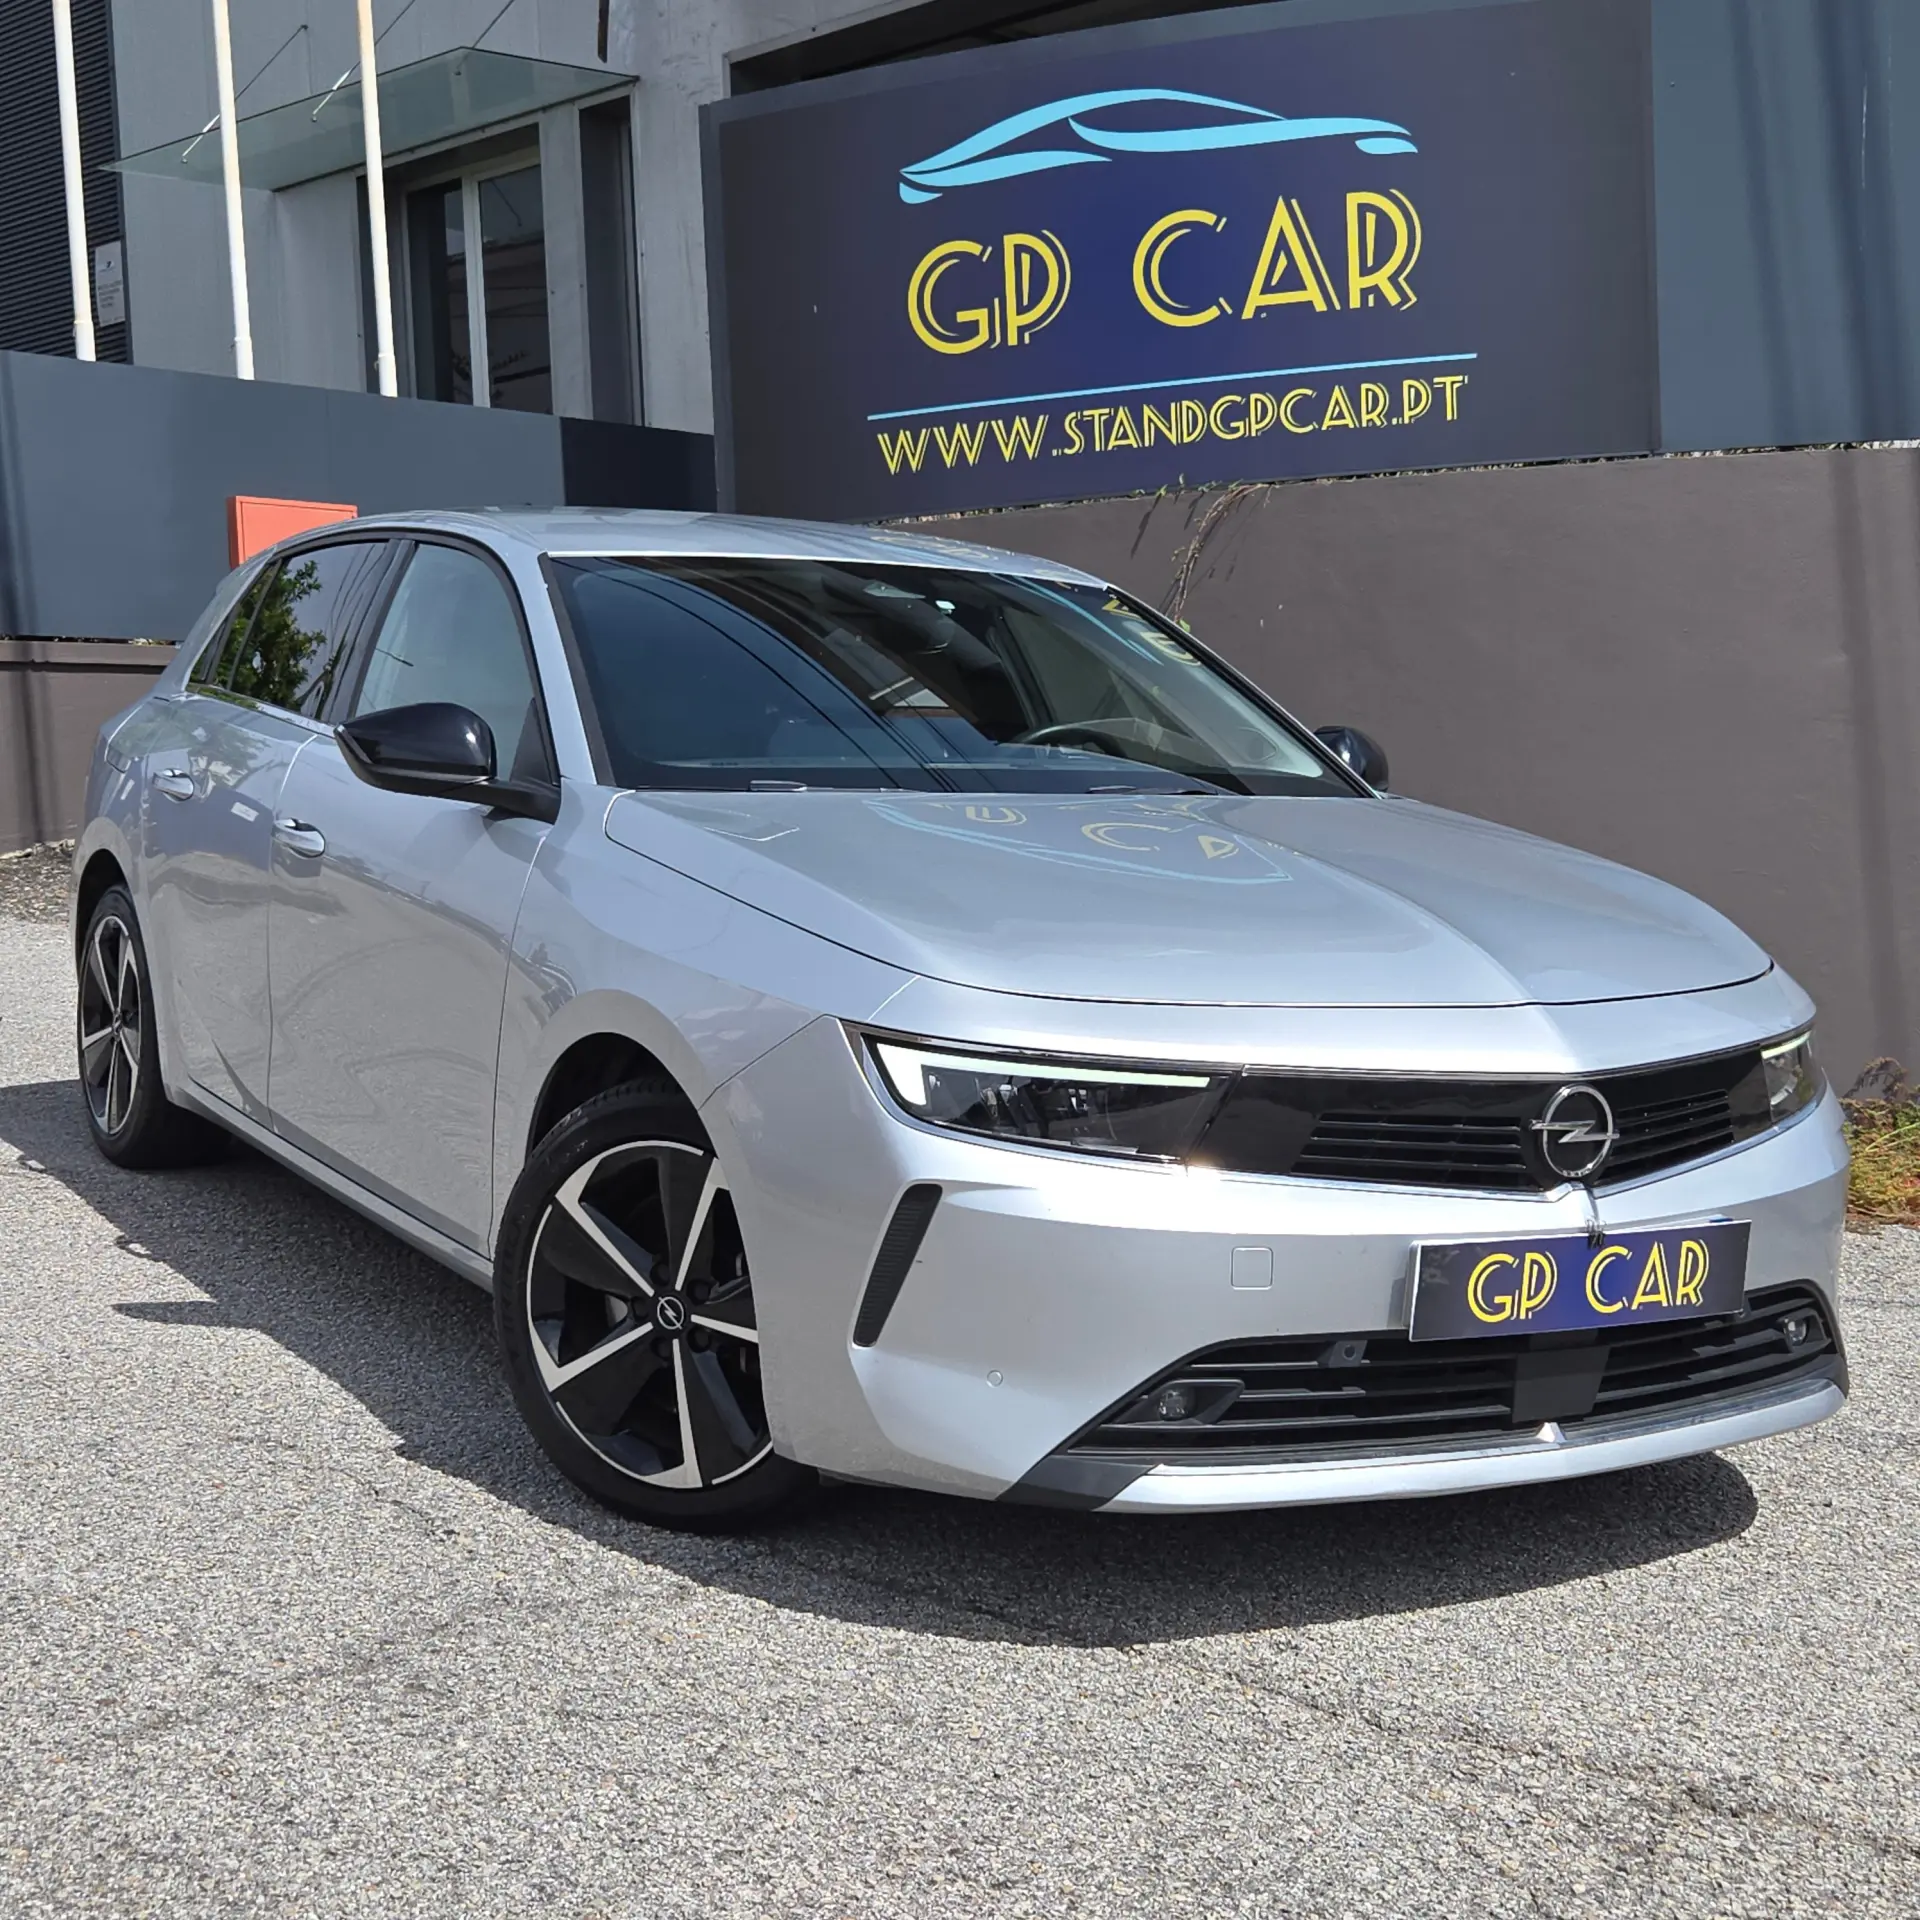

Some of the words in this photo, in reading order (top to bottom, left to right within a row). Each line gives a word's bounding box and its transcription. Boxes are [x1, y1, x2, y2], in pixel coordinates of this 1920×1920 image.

[908, 229, 1072, 355] GP
[1133, 188, 1423, 328] CAR
[877, 374, 1469, 476] WWW.STANDGPCAR.PT
[1467, 1251, 1558, 1323] GP
[1585, 1238, 1710, 1314] CAR
